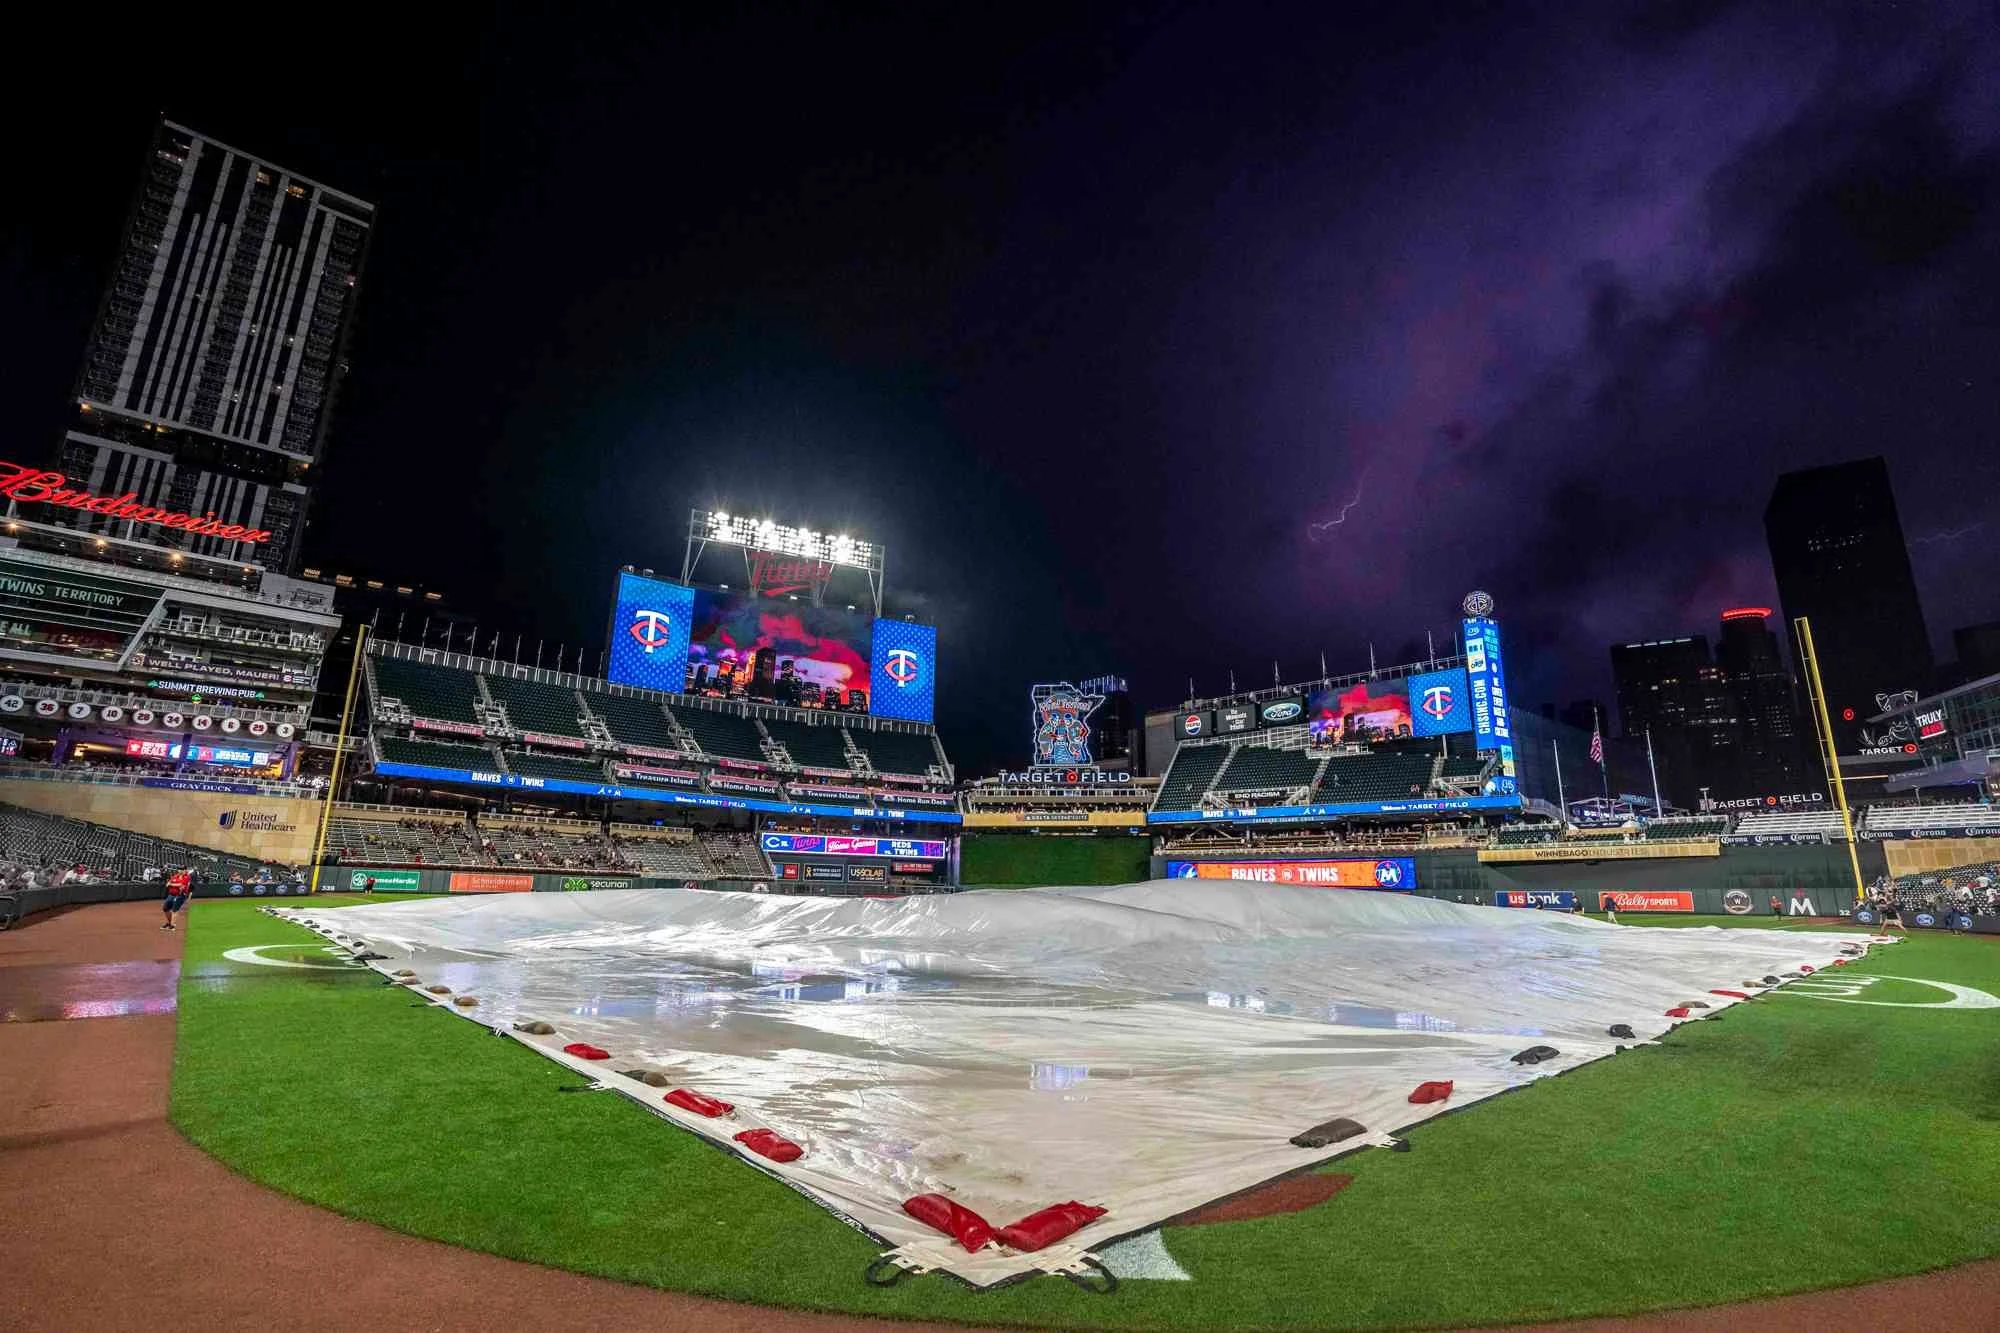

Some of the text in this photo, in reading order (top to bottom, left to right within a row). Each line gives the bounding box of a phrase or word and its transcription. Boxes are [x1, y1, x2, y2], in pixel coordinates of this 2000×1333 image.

[0, 462, 271, 543] Budweiser
[0, 577, 124, 607] TWINS TERRITORY
[149, 659, 279, 681] WELL PLAYED, MAUER!
[159, 681, 256, 698] SUMMIT BREWING PUB
[4, 699, 18, 708] 42
[39, 703, 54, 712] 36
[76, 706, 84, 715] 7
[106, 710, 117, 718] 10
[196, 718, 208, 726] 14
[1916, 709, 1942, 728] TRULY
[1859, 746, 1903, 756] TARGET
[472, 772, 501, 783] BRAVES
[521, 777, 544, 787] TWINS
[636, 772, 693, 785] Treasure Island
[999, 772, 1130, 784] TARGET FIELD
[171, 782, 202, 791] GRAY
[202, 784, 232, 792] DUCK
[723, 782, 775, 794] Home Run Deck
[807, 790, 860, 800] Treasure Island
[1251, 791, 1281, 799] RACISM
[699, 798, 722, 807] TARGET
[1713, 792, 1823, 809] TARGET FIELD
[1408, 802, 1438, 810] TARGET
[853, 808, 904, 818] BRAVES TWINS
[1203, 808, 1257, 818] BRAVES TWINS
[241, 811, 296, 832] United Healthcare
[1790, 833, 1820, 841] Corona
[1860, 830, 1894, 840] Corona
[1911, 829, 1947, 838] Corona
[792, 836, 821, 851] Twins
[1721, 836, 1748, 844] Corona
[1755, 835, 1783, 843] Corona
[828, 837, 876, 852] Home Games
[891, 841, 911, 849] REDS
[895, 848, 918, 857] TWINS
[1535, 849, 1588, 859] WINNEBAGO
[1231, 868, 1275, 882] BRAVES
[1299, 868, 1338, 882] TWINS
[591, 879, 628, 889] securian
[1510, 894, 1525, 905] us
[1615, 893, 1678, 910] Bally SPORTS
